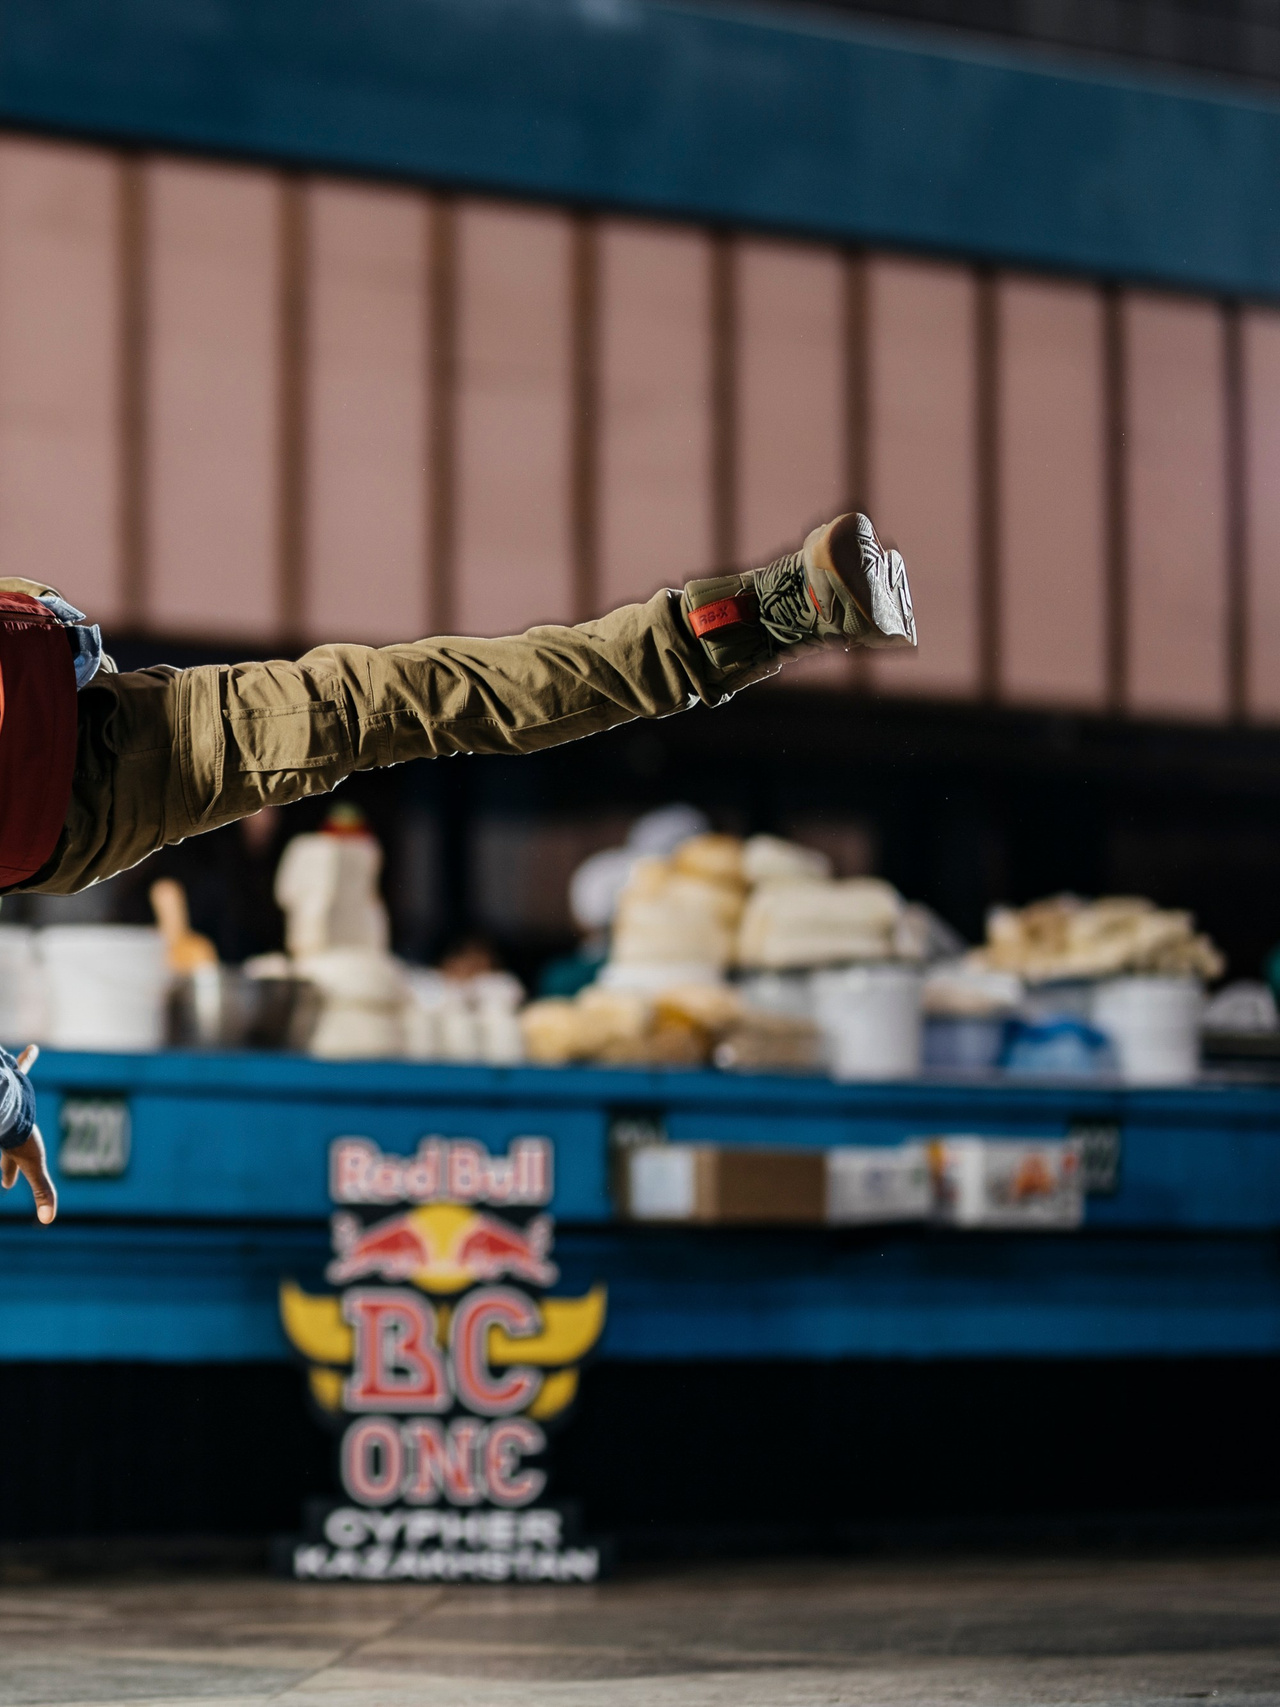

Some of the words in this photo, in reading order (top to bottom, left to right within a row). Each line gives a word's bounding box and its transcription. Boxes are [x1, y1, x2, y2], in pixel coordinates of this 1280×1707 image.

[699, 606, 729, 626] RS-X
[332, 1139, 440, 1201] Red
[447, 1139, 552, 1201] Bull
[344, 1290, 541, 1413] BC
[342, 1417, 546, 1504] ONE
[324, 1507, 562, 1548] CYPHER
